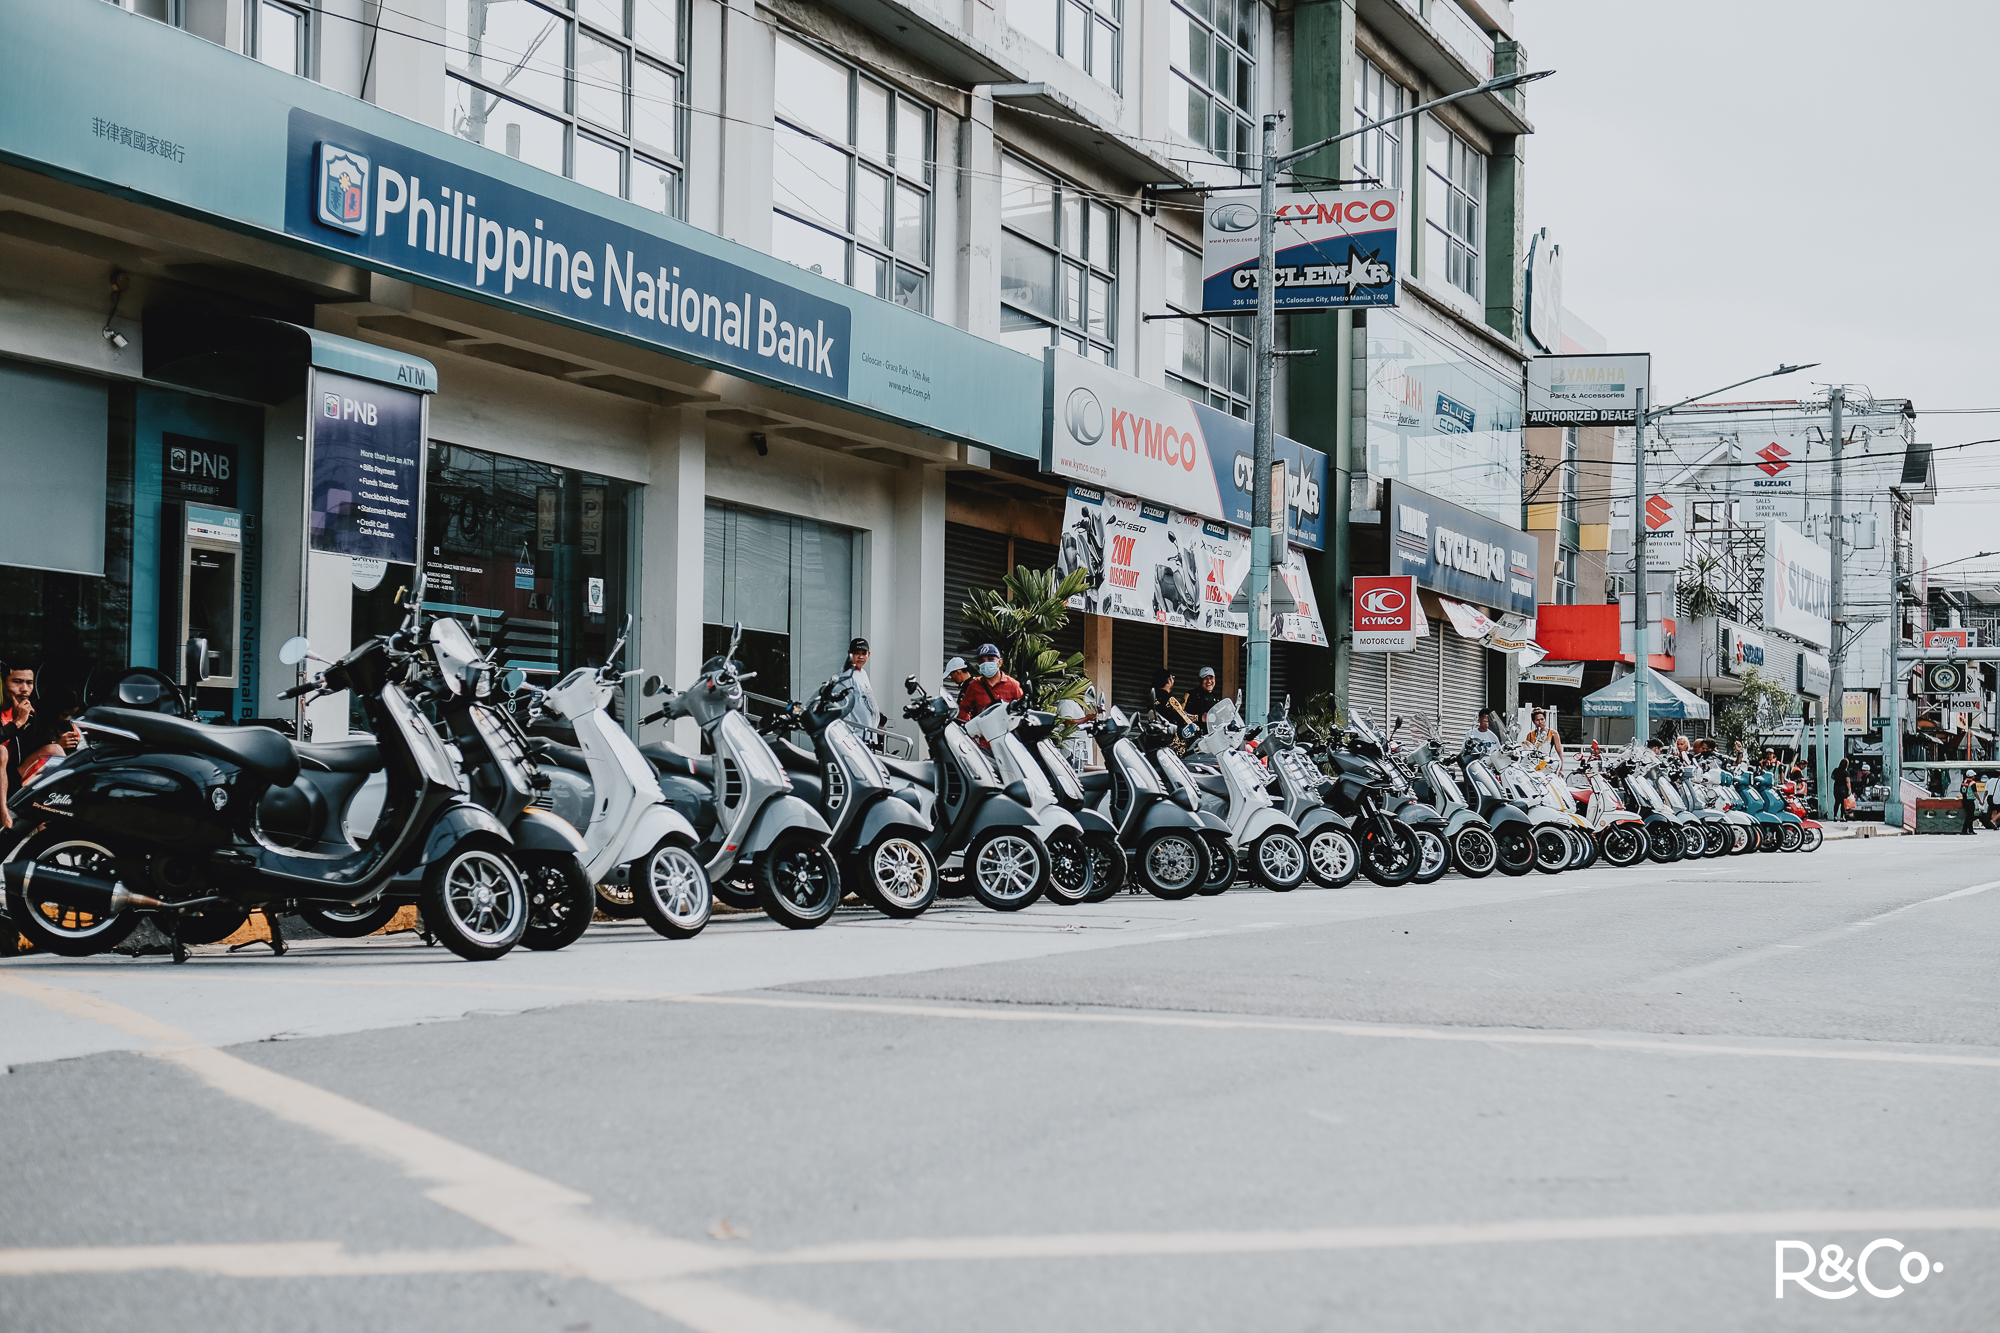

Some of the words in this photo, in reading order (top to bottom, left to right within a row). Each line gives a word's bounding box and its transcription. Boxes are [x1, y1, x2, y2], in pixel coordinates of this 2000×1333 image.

[92, 116, 185, 164] 菲律賓國家銀行
[1276, 199, 1396, 226] KYMCO
[375, 165, 595, 300] Philippine
[604, 243, 750, 350] National
[758, 305, 835, 378] Bank
[1286, 296, 1315, 305] Caloocan
[1331, 294, 1349, 303] Metro
[1350, 293, 1372, 302] Manila
[397, 363, 426, 387] ATM
[861, 352, 882, 367] Caloocan
[885, 360, 899, 373] Grace
[898, 364, 909, 376] Park
[912, 369, 922, 381] 10th
[1567, 367, 1626, 383] YAMAHA
[888, 380, 931, 402] www.pnb.com.ph
[1564, 384, 1612, 392] GENUINE
[343, 397, 378, 427] PNB
[1441, 399, 1471, 424] BLUE
[1530, 410, 1599, 422] AUTHORIZED
[1600, 409, 1636, 421] DEALE
[1439, 417, 1469, 441] CORE
[1111, 407, 1196, 472] KYMCO
[190, 449, 230, 480] PNB
[360, 449, 374, 459] More
[374, 452, 386, 461] than
[386, 454, 396, 463] just
[396, 457, 403, 465] an
[403, 458, 415, 467] ATM
[362, 463, 374, 472] Bills
[374, 466, 397, 476] Payment
[1060, 456, 1108, 479] www.kymco.com.ph
[362, 477, 378, 487] Funds
[378, 480, 399, 490] Transfer
[361, 491, 390, 503] Checkbook
[389, 496, 410, 506] Request
[1116, 498, 1137, 512] KYMCO
[360, 504, 387, 516] Statement
[386, 508, 407, 519] Request
[222, 517, 239, 528] ATM
[359, 518, 376, 528] Credit
[376, 521, 389, 530] Card
[359, 527, 373, 535] Cash
[372, 529, 395, 539] Advance
[1111, 534, 1137, 567] 20K
[242, 533, 257, 623] Philippine
[515, 566, 534, 576] CLOSED
[1109, 566, 1140, 590] DISCOUNT
[1788, 560, 1831, 621] SUZUKI
[1361, 616, 1404, 626] KYMCO
[1359, 637, 1405, 646] MOTORCYCLE
[241, 626, 255, 703] National
[1952, 700, 1978, 708] KOBY
[43, 791, 73, 807] Stella
[32, 801, 75, 818] Primavera
